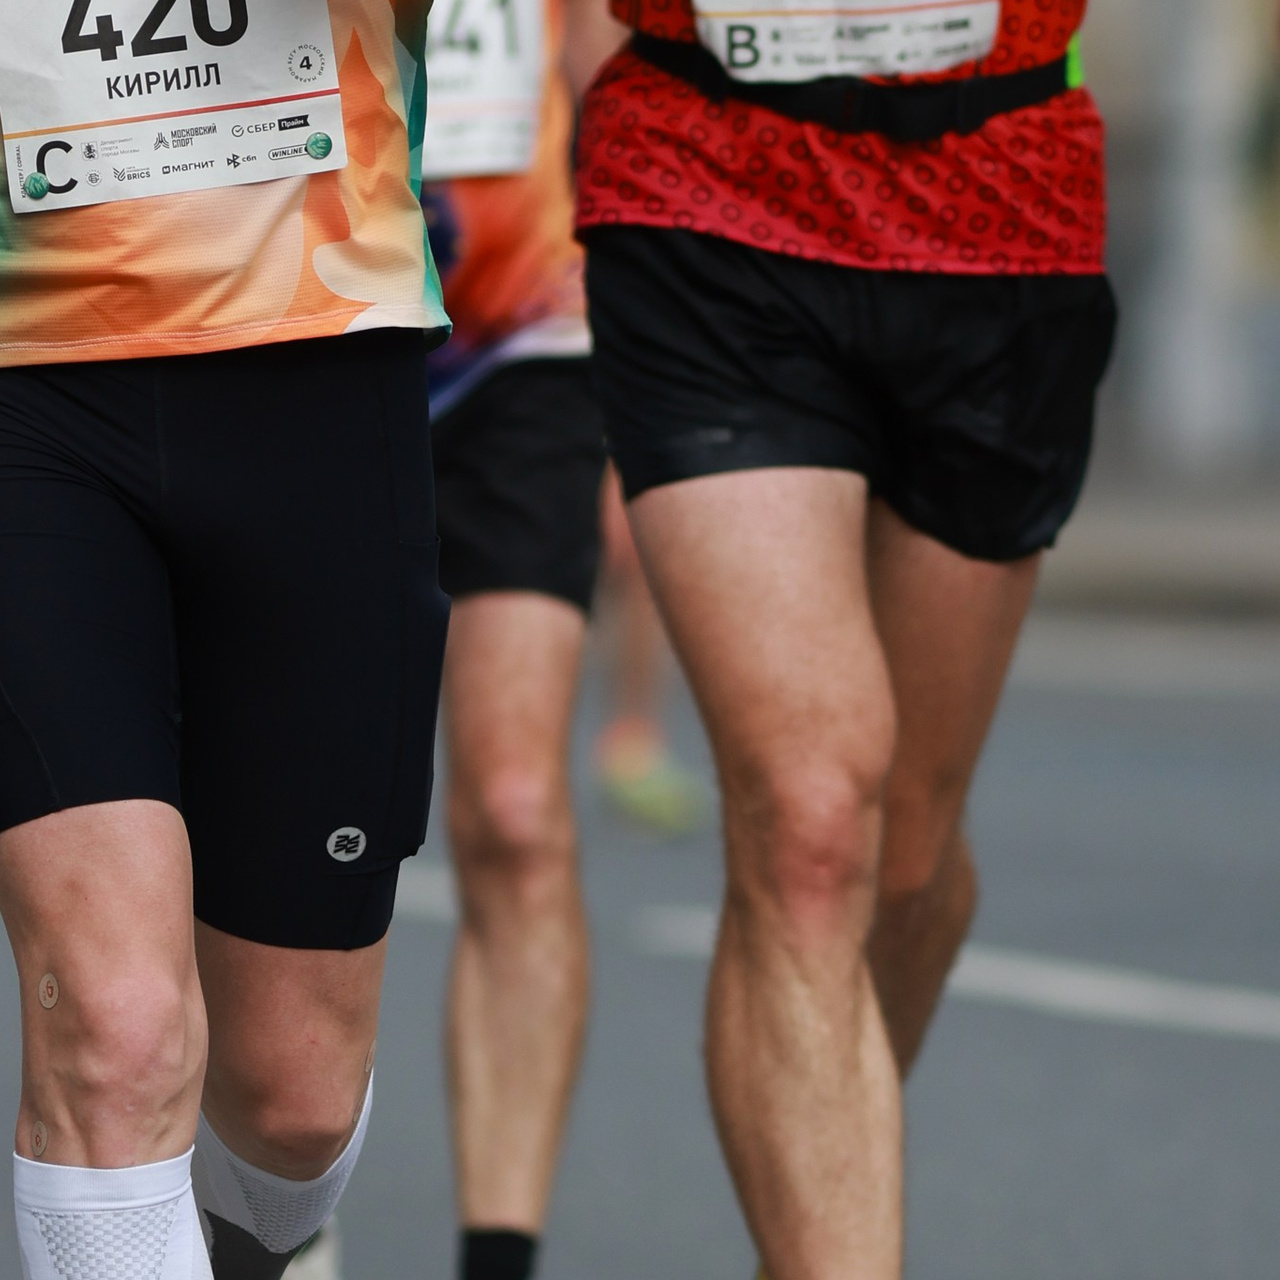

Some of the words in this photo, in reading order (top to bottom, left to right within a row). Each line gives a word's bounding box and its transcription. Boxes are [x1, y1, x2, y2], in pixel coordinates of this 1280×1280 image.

[299, 56, 312, 70] 4
[105, 62, 222, 100] КИРИЛЛ
[171, 123, 217, 138] МОСКОВСКИЙ
[247, 122, 276, 134] СБЕР
[172, 137, 194, 149] СПОРТ
[271, 147, 304, 159] WINLINE
[126, 171, 151, 181] BRICS
